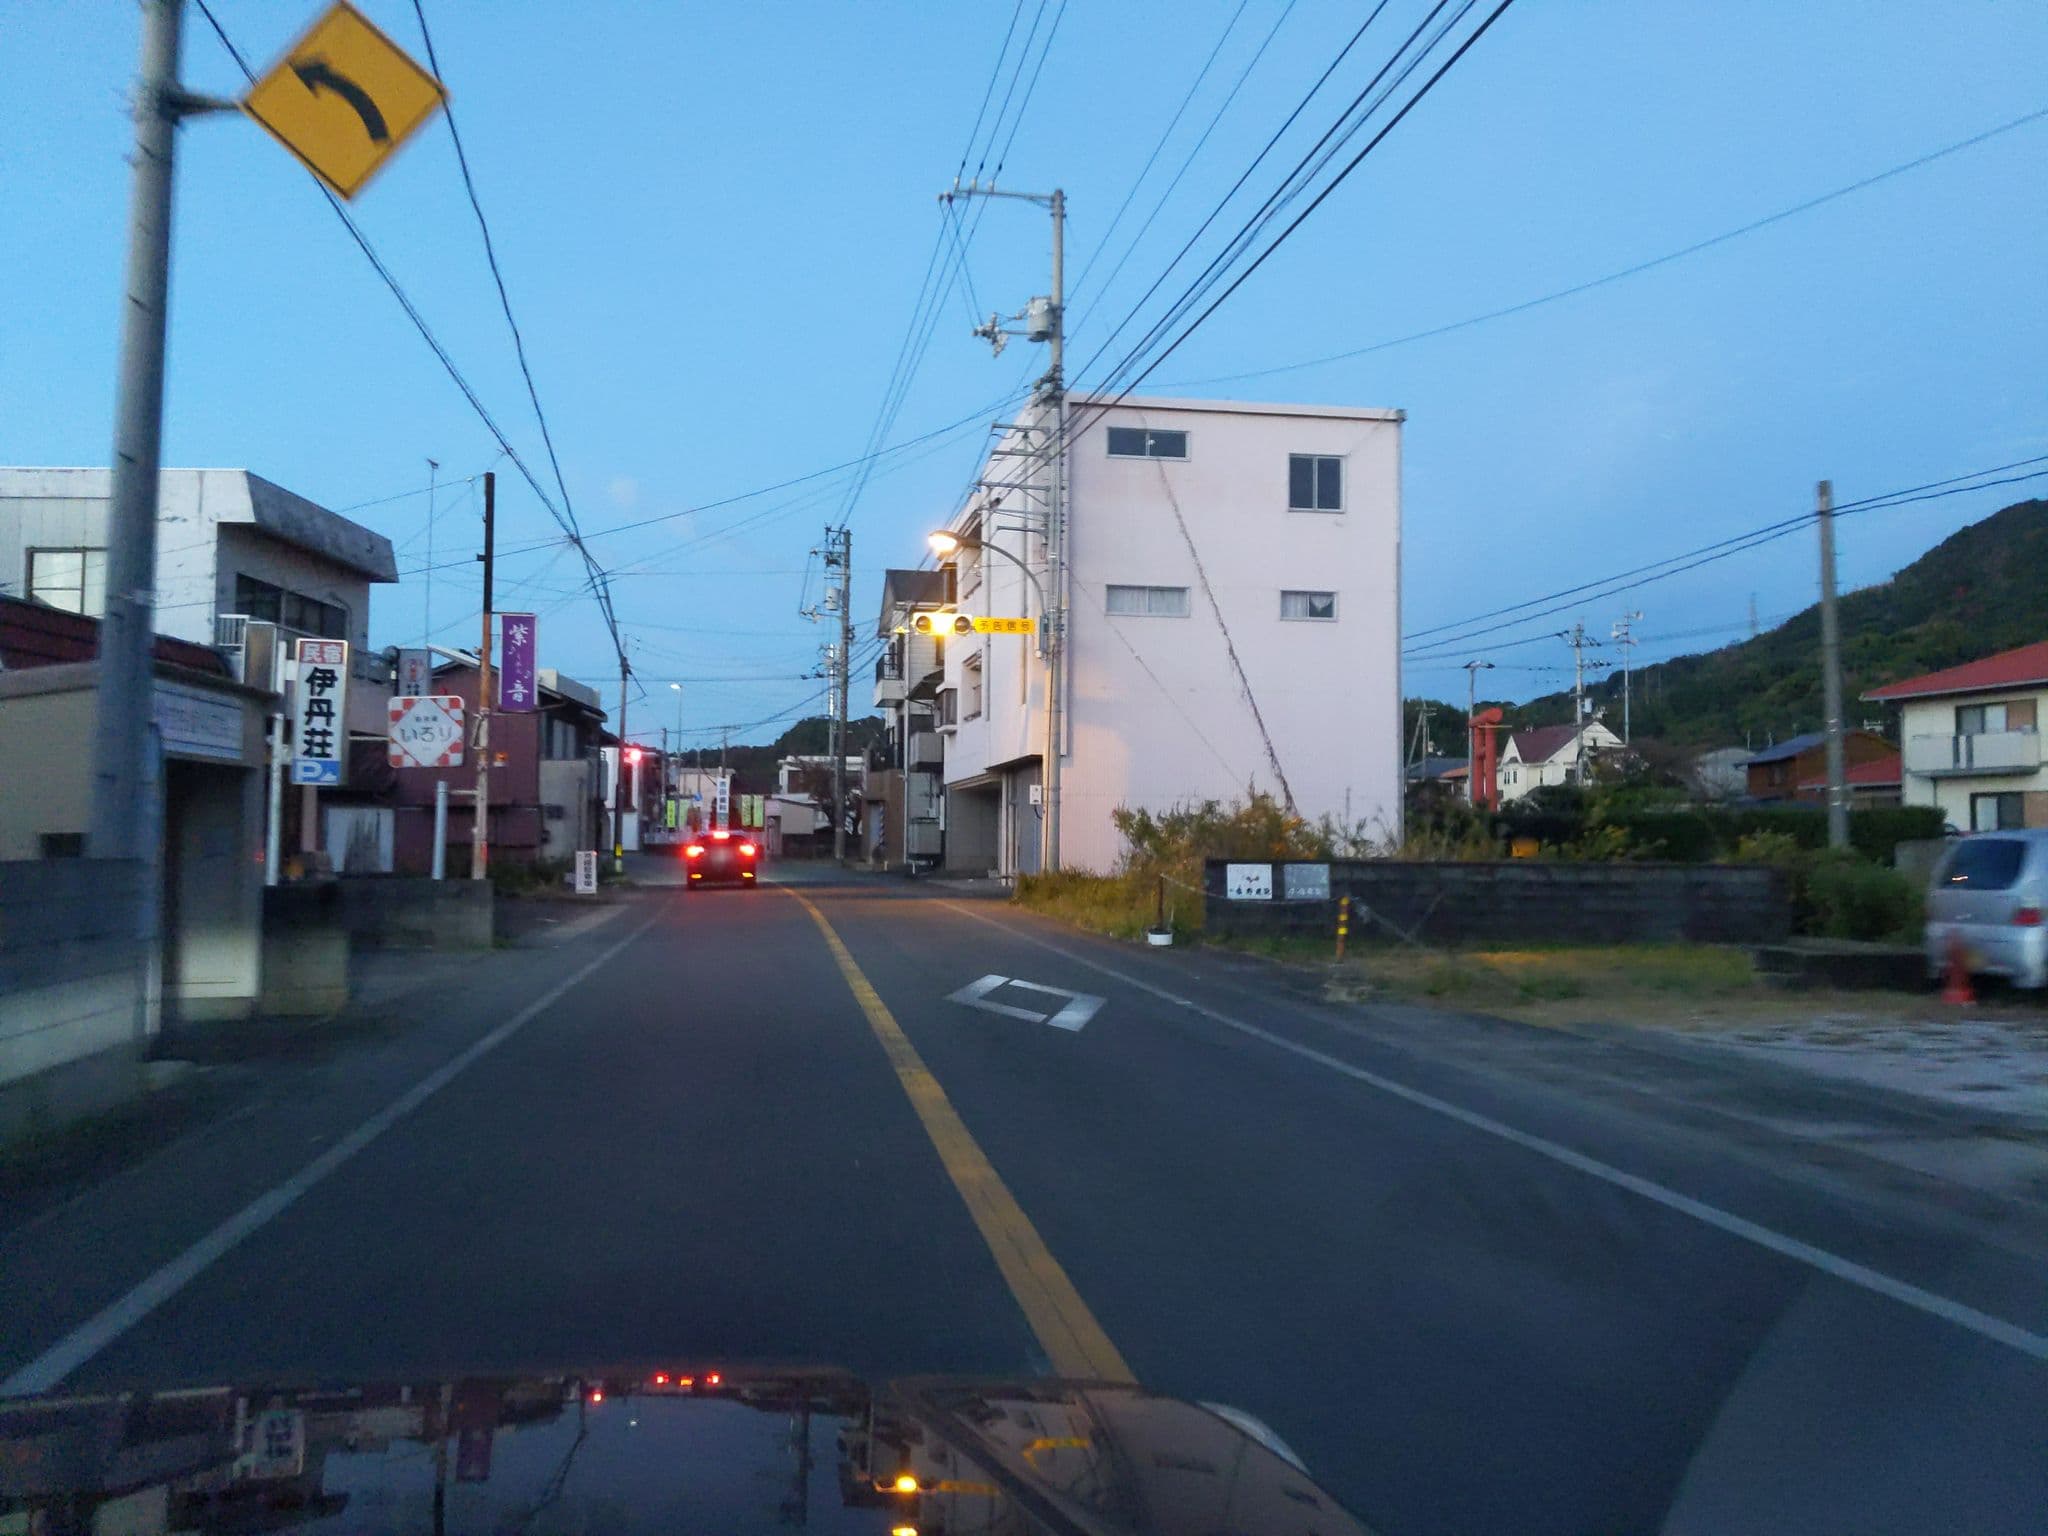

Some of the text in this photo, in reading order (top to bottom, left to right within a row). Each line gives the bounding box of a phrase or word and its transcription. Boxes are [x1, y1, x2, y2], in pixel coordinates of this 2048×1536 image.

[980, 621, 1031, 632] 予告信号
[303, 643, 342, 662] 民宿
[302, 667, 338, 758] 伊丹荘
[400, 727, 452, 742] いろり
[296, 761, 323, 782] P
